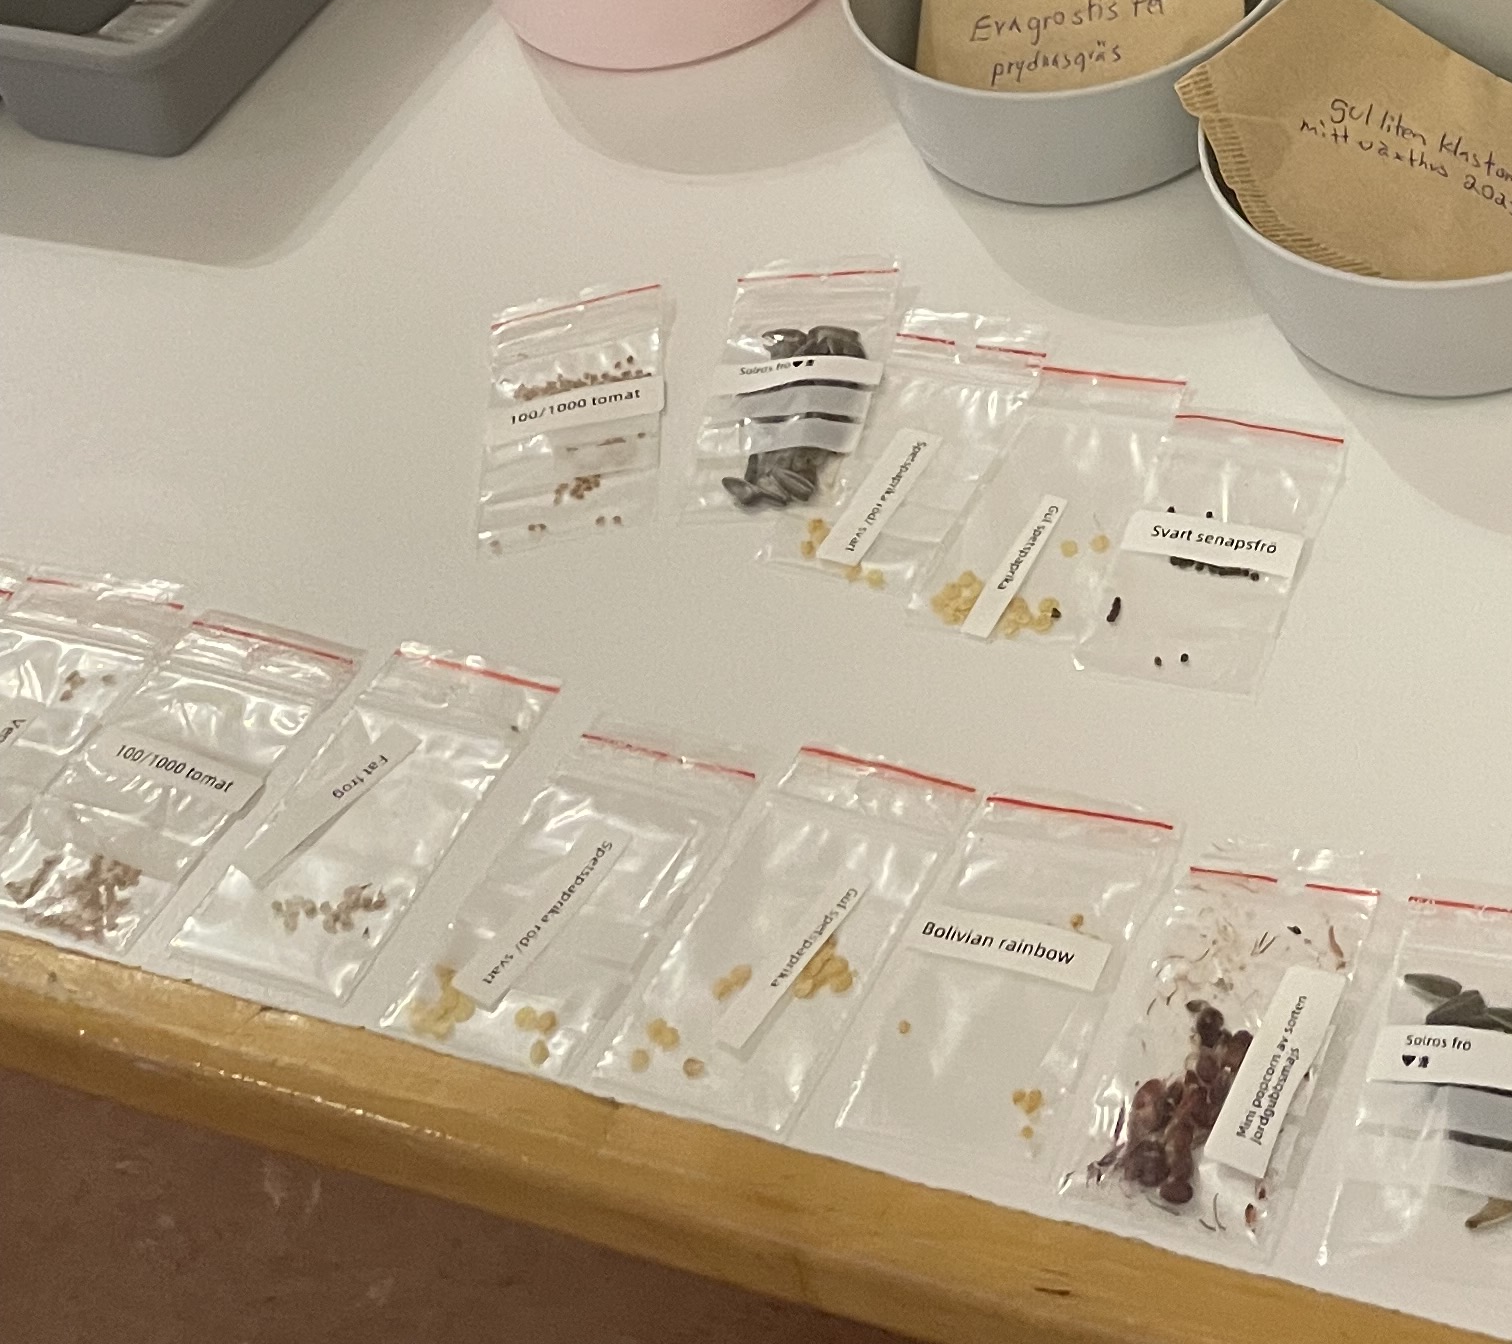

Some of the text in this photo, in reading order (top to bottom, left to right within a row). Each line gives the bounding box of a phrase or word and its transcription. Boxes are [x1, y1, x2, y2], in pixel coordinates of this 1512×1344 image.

[1380, 110, 1427, 146] liten
[510, 388, 641, 426] 100/1000 tomat
[996, 505, 1059, 591] Gul spetspaprika
[1150, 523, 1279, 556] Svart senapsfrö
[114, 743, 236, 794] 100/1000 tomat
[332, 754, 389, 799] Fat frog
[836, 887, 858, 910] Gul
[921, 920, 1076, 966] Bolivian rainbow
